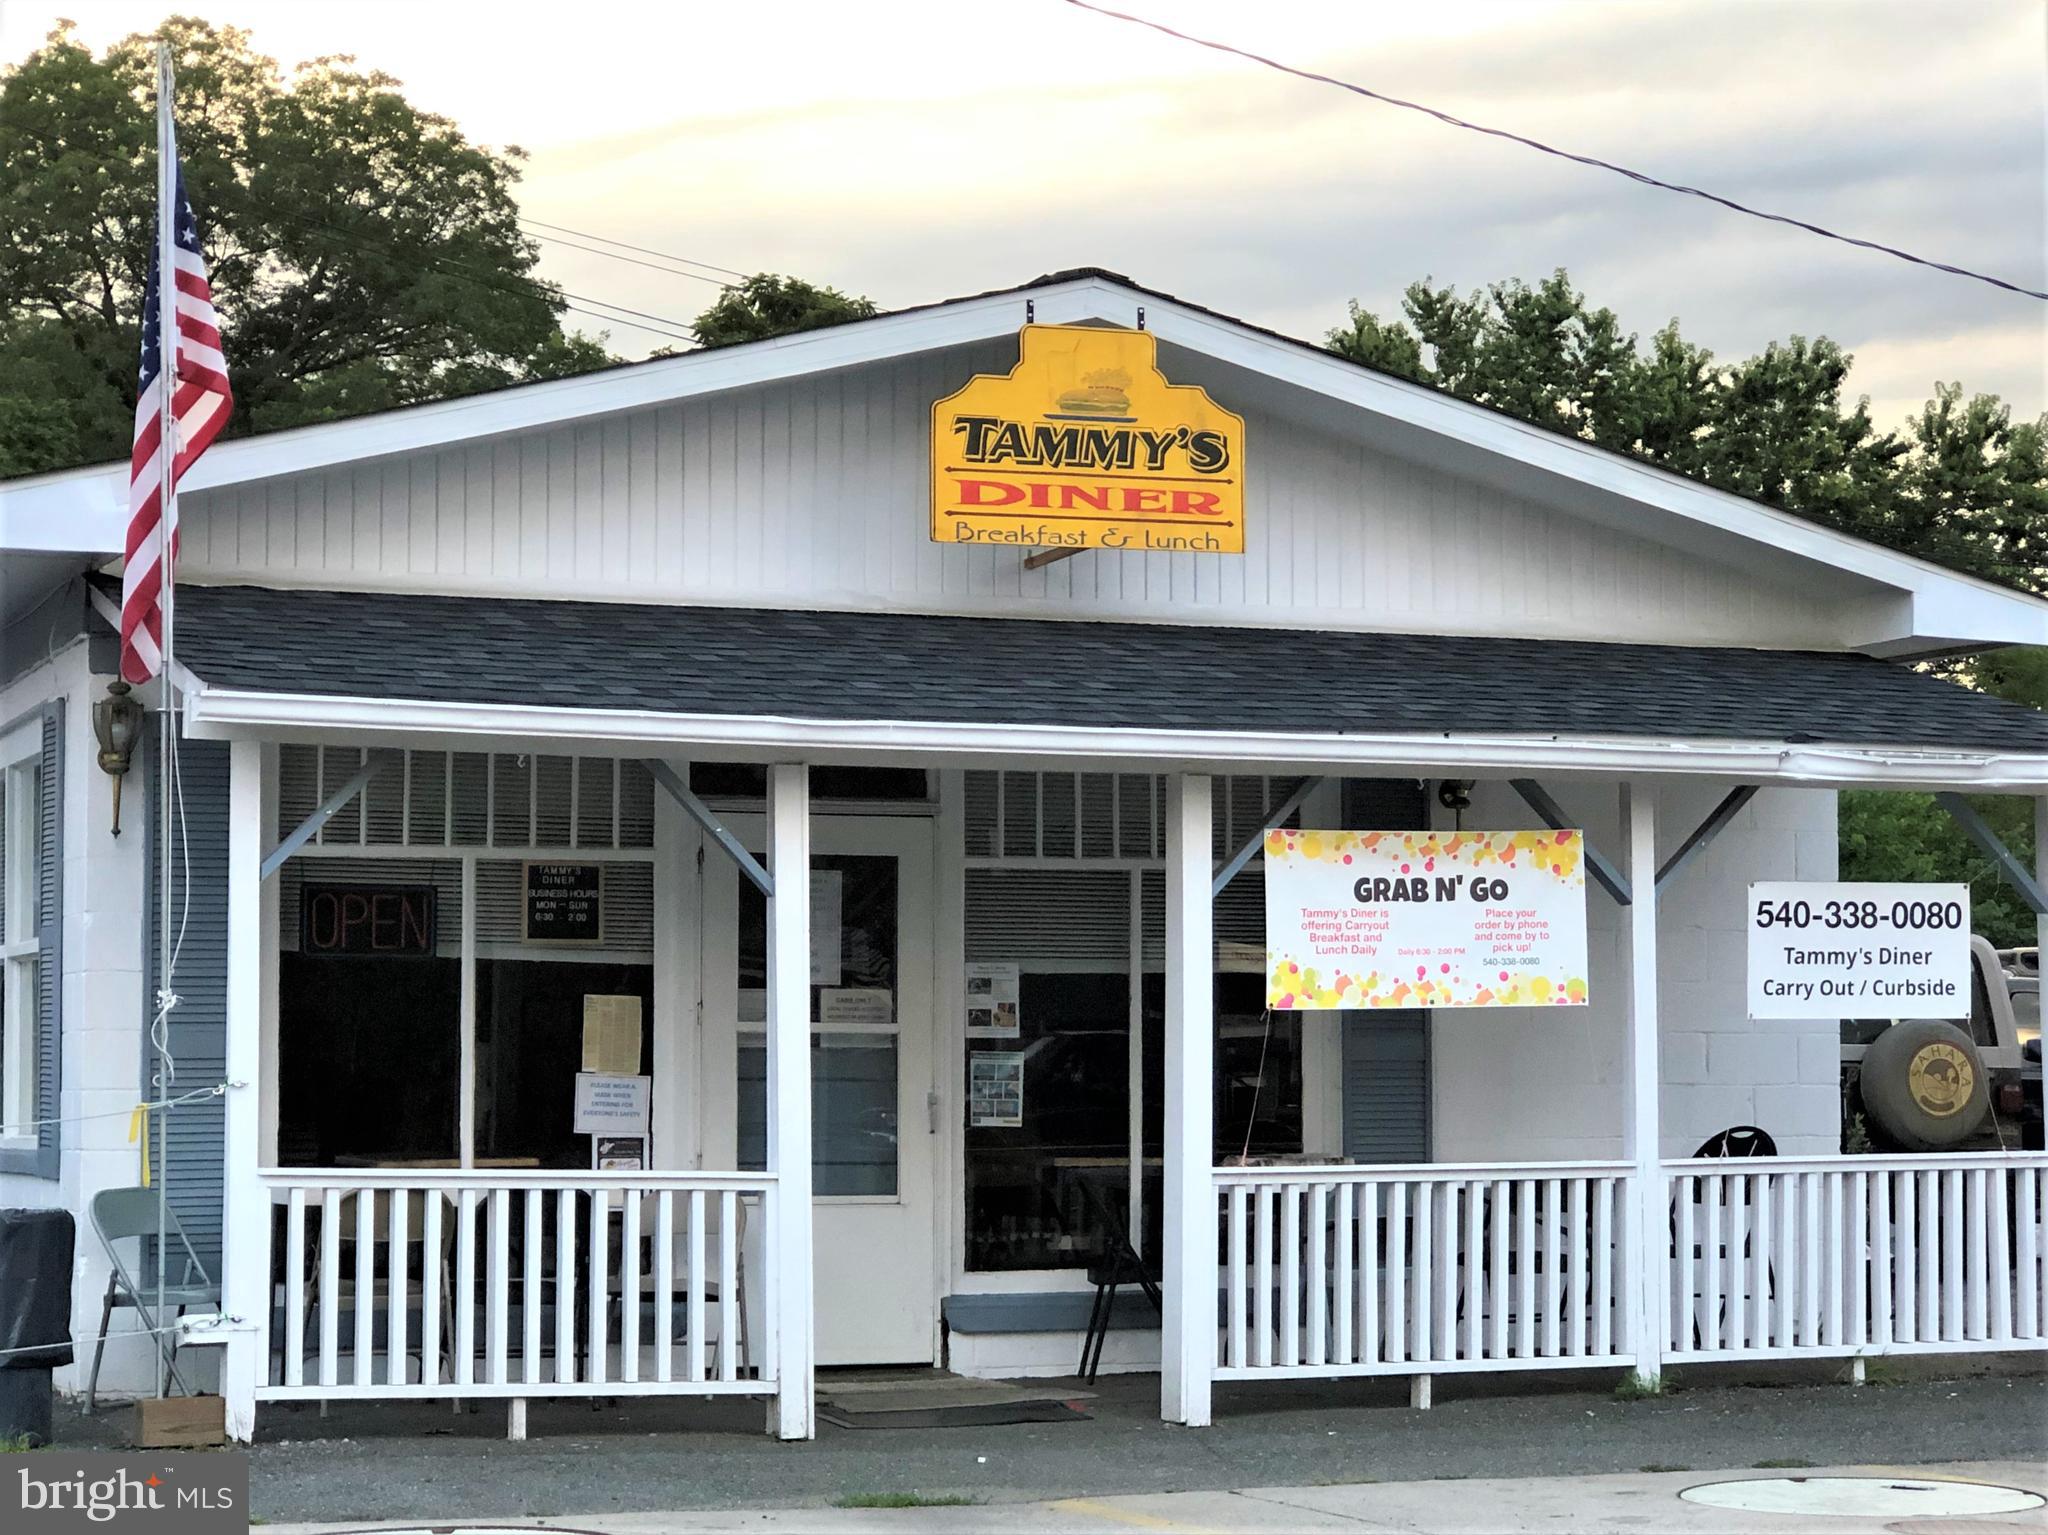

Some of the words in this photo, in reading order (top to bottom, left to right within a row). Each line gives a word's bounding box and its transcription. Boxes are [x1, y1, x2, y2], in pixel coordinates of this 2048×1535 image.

[951, 415, 1230, 474] TAMMY'S
[952, 479, 1224, 516] DINER
[956, 521, 1087, 546] Breakfast
[1101, 527, 1132, 548] &
[1145, 529, 1220, 550] Lunch
[542, 875, 575, 885] DINER
[528, 888, 568, 898] BUSINESS
[569, 889, 599, 899] HOURS
[1354, 877, 1429, 903] GRAB
[1435, 874, 1463, 903] N'
[1470, 876, 1509, 902] GO
[536, 900, 557, 910] MON
[568, 900, 588, 910] SUN
[1301, 908, 1348, 921] Tammy's
[1351, 908, 1377, 918] Diner
[1380, 908, 1390, 918] is
[1485, 908, 1513, 918] Place
[1515, 909, 1537, 920] your
[1756, 900, 1962, 930] 540-338-0080
[311, 892, 428, 950] OPEN
[1301, 920, 1342, 932] offering
[1345, 920, 1390, 932] Carryout
[1474, 920, 1501, 930] order
[1504, 920, 1515, 931] by
[1517, 919, 1549, 931] phone
[1309, 932, 1361, 943] Breakfast
[1363, 932, 1383, 943] and
[1474, 931, 1493, 941] and
[1495, 932, 1522, 941] come
[1525, 931, 1537, 942] by
[1540, 931, 1550, 941] to
[1315, 944, 1348, 955] Lunch
[1351, 944, 1377, 958] Daily
[1397, 948, 1414, 957] Daily
[1453, 947, 1466, 955] PM
[1492, 943, 1513, 954] pick
[1516, 942, 1532, 954] up!
[1482, 956, 1541, 967] 540-338-0080
[1784, 946, 1873, 970] Tammy's
[1879, 947, 1933, 966] Diner
[1763, 979, 1814, 1001] Carry
[1820, 979, 1855, 997] Out
[1859, 979, 1868, 997] /
[1872, 979, 1956, 997] Curbside
[1911, 1045, 1972, 1087] SAHARA
